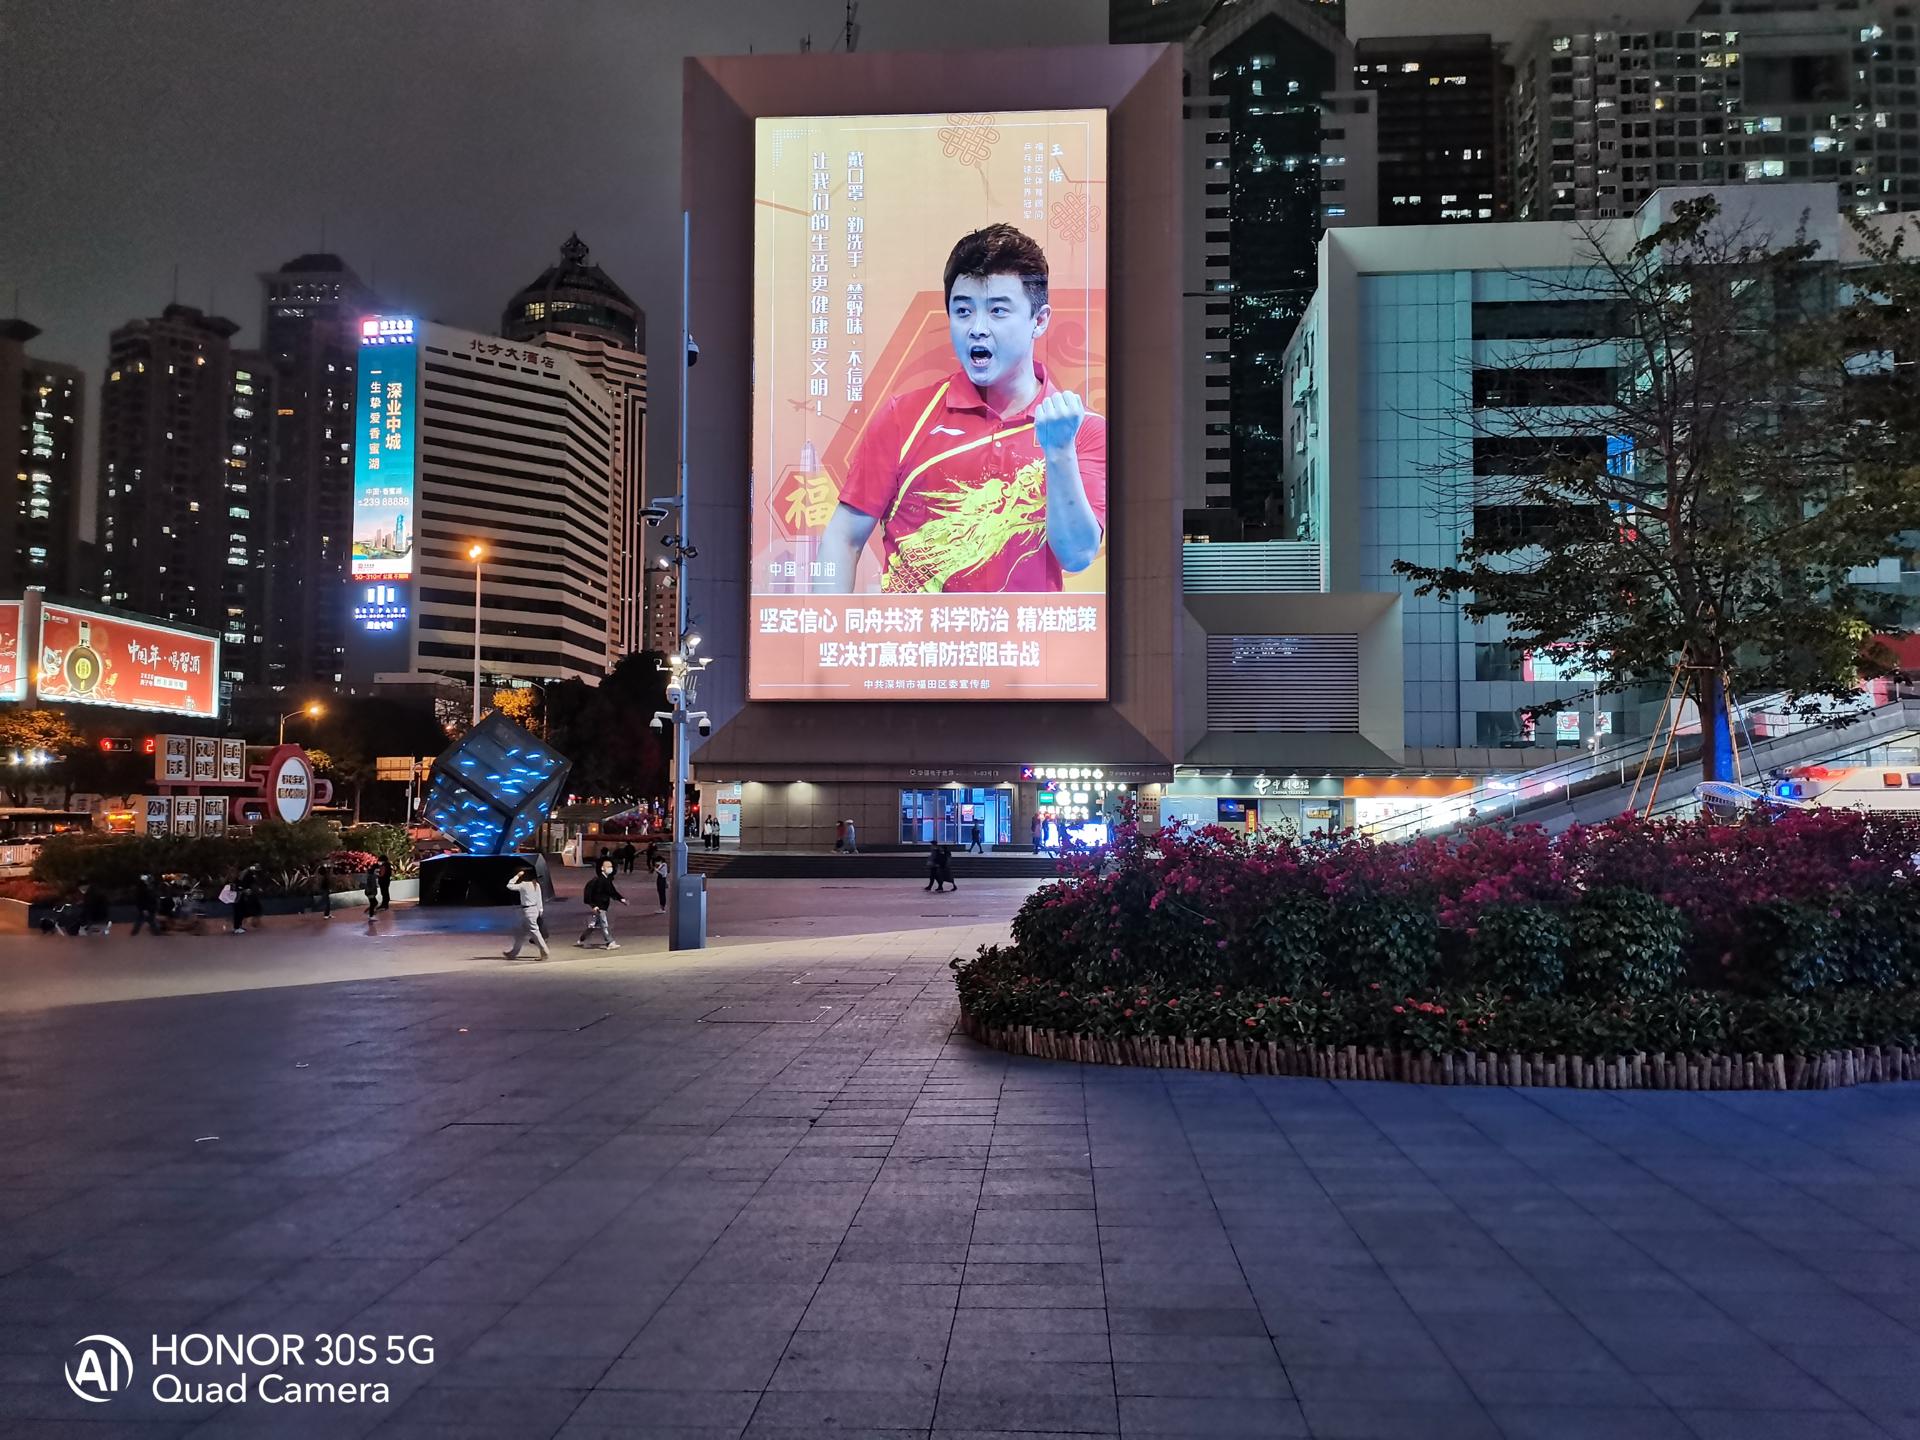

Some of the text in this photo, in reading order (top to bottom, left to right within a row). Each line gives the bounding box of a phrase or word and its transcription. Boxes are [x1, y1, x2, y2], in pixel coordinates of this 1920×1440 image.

[469, 339, 555, 369] 北方大酒店
[385, 383, 403, 450] 深业中城
[785, 474, 832, 530] 福
[760, 606, 1097, 633] 坚定信心 同舟共济 科学防治 精准施策
[819, 641, 1040, 668] 坚决打赢疫情防控阻击战
[864, 680, 991, 690] 中共深圳市福田区委宣传部
[1272, 779, 1310, 790] 中国电信
